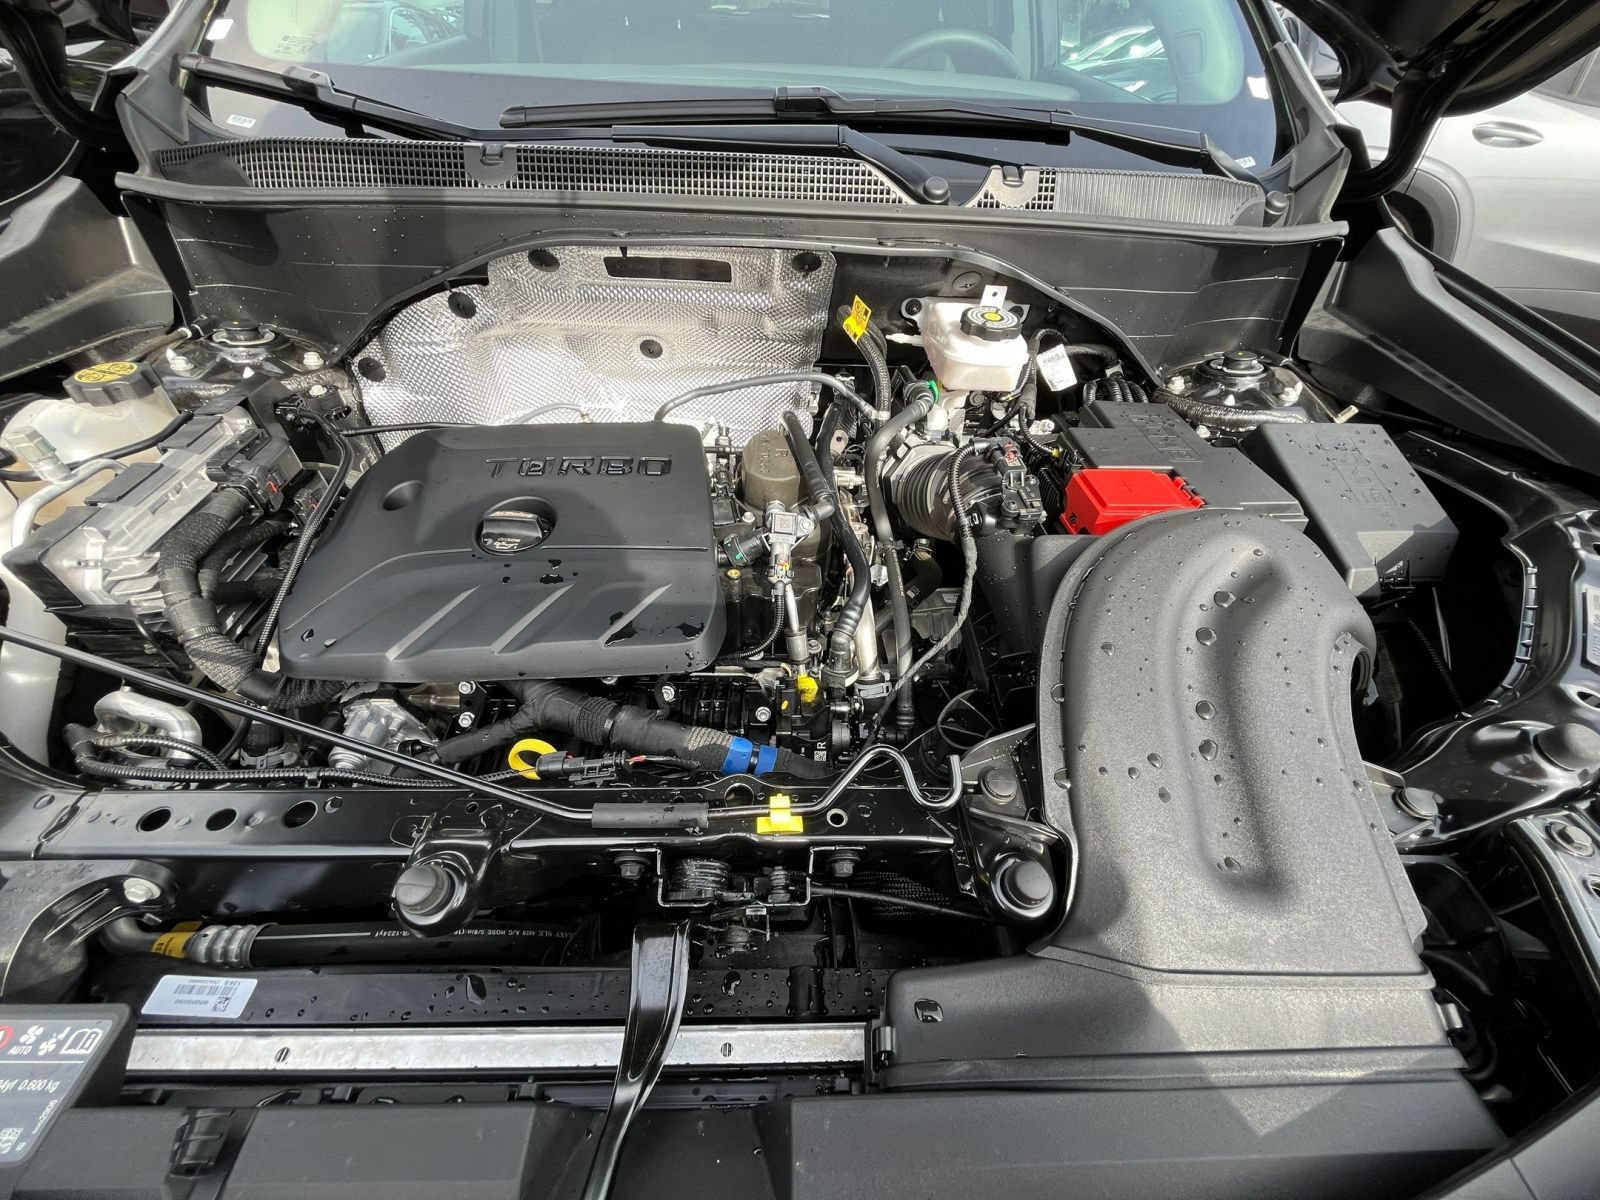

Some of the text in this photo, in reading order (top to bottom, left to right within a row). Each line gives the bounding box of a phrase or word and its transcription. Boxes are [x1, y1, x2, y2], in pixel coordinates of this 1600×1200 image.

[485, 455, 673, 478] TURBO
[487, 929, 506, 937] HOSE
[8, 1045, 33, 1055] AUTO
[18, 1079, 46, 1091] 0.600
[44, 1079, 61, 1093] kg
